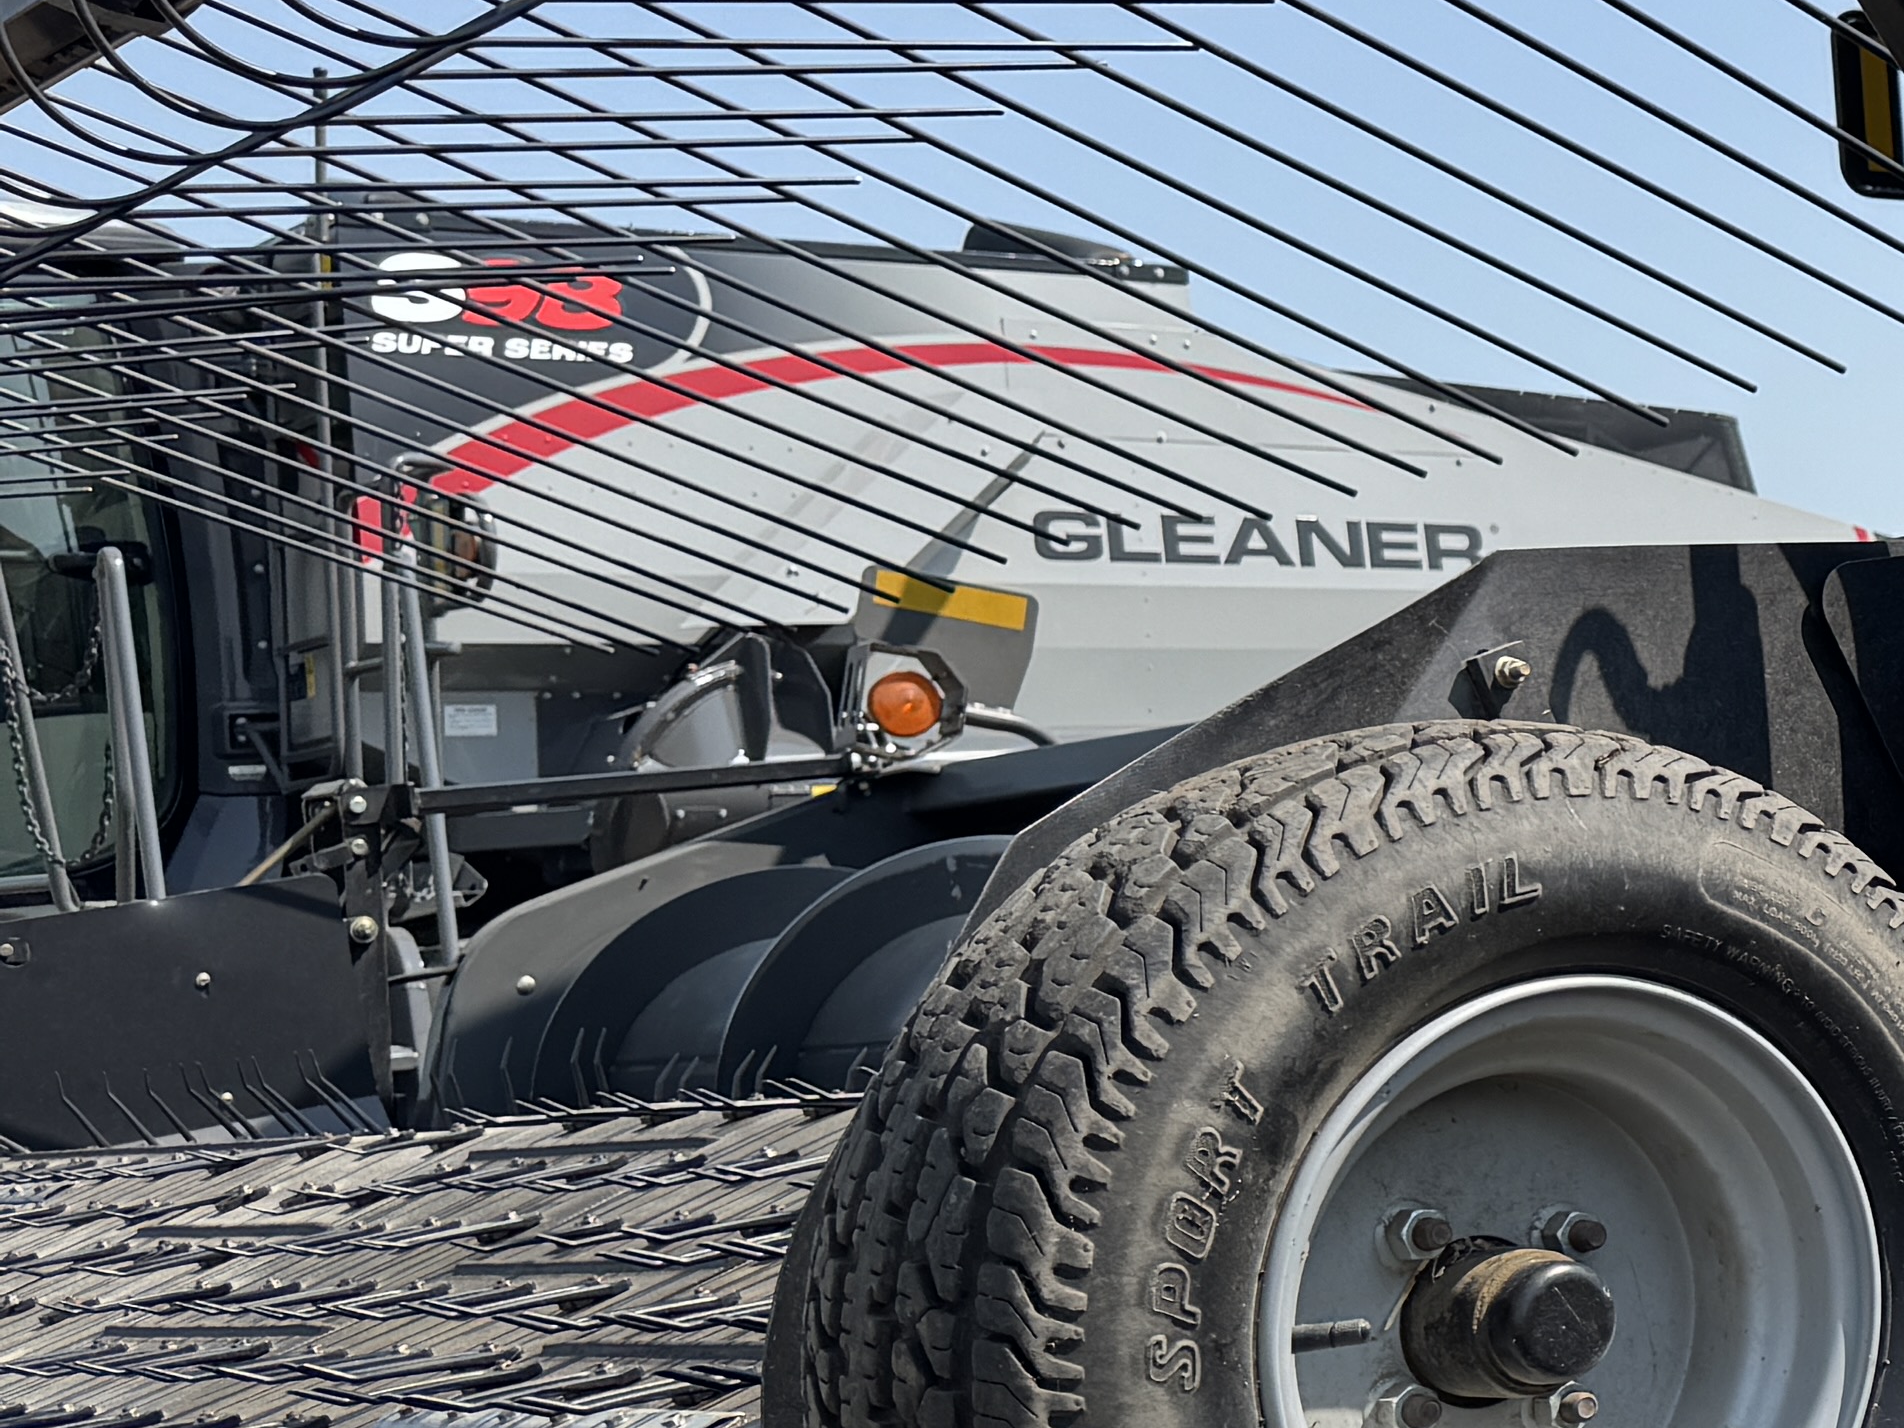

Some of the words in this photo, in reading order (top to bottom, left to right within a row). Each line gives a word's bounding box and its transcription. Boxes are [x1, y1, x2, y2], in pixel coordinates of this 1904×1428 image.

[1033, 510, 1484, 571] GLEANER
[1302, 851, 1543, 1015] TRAIL
[1148, 1055, 1265, 1393] SPORT
